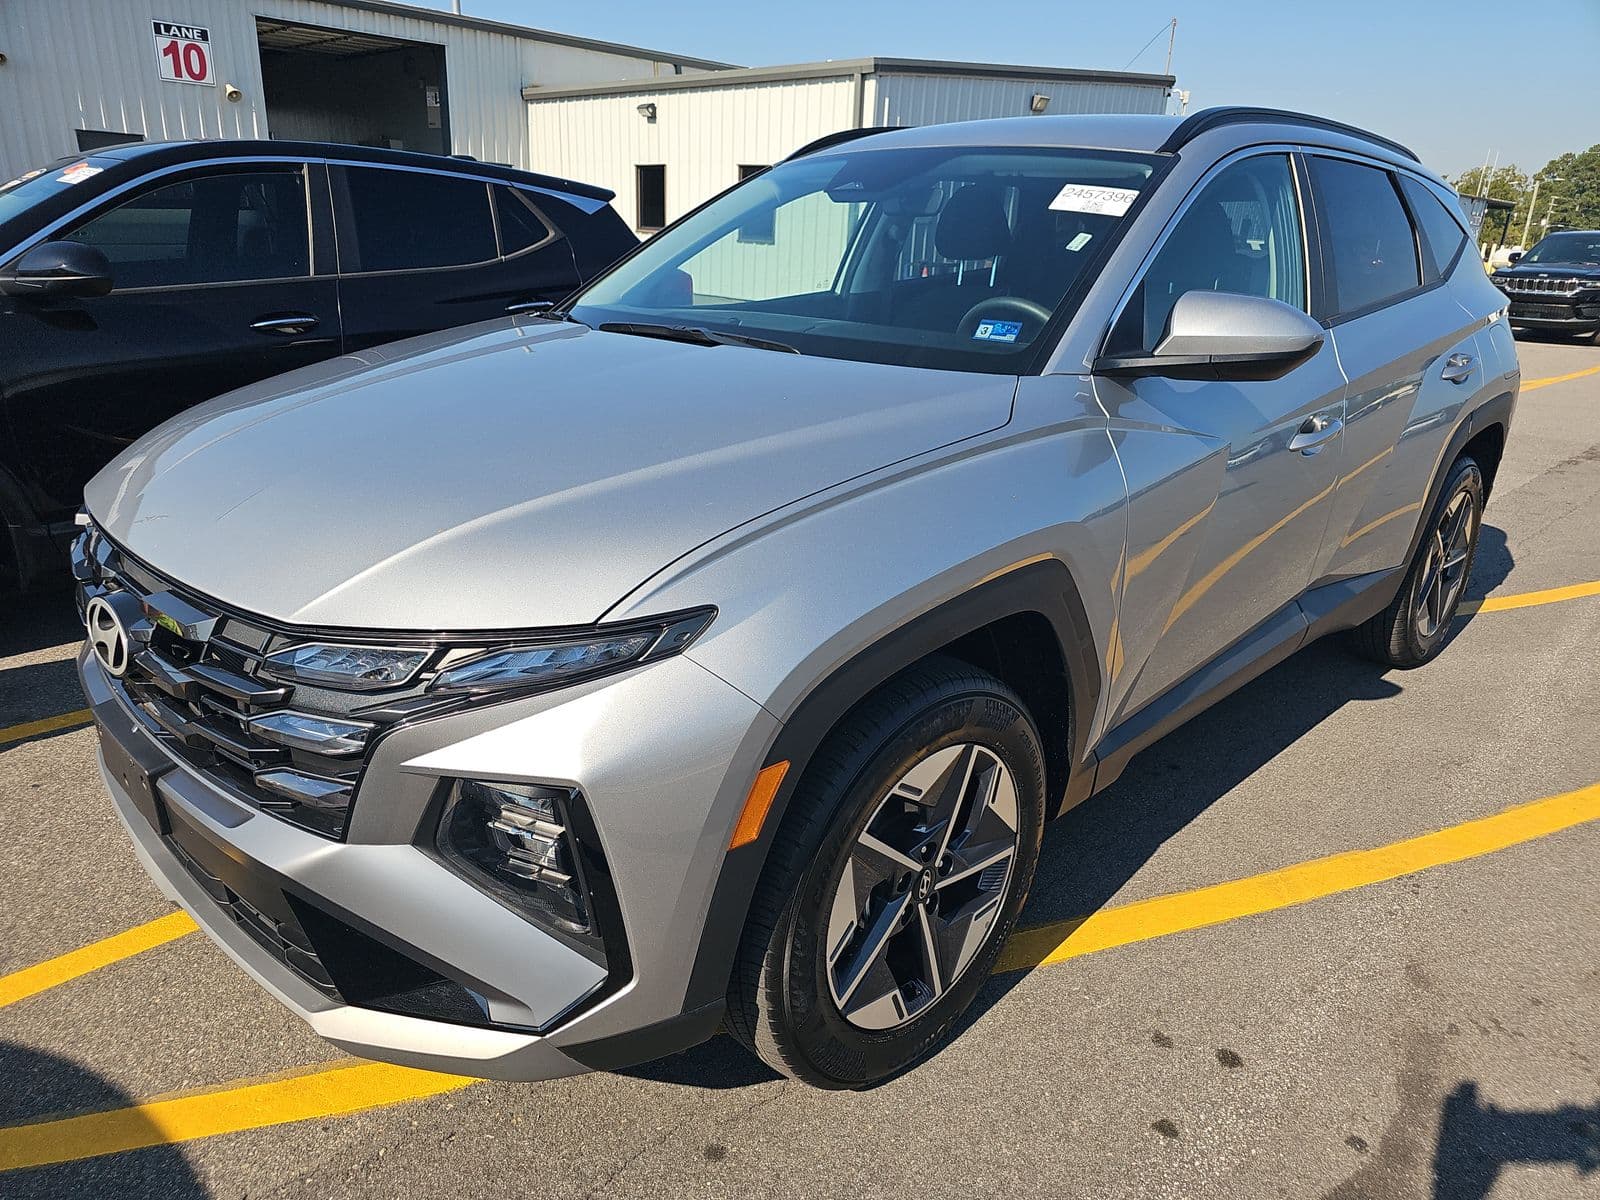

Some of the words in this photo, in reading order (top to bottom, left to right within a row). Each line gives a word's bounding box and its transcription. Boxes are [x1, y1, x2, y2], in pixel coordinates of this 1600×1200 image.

[160, 24, 202, 40] LANE
[162, 40, 207, 81] 10
[1062, 187, 1136, 204] 2457396
[980, 326, 989, 335] 3
